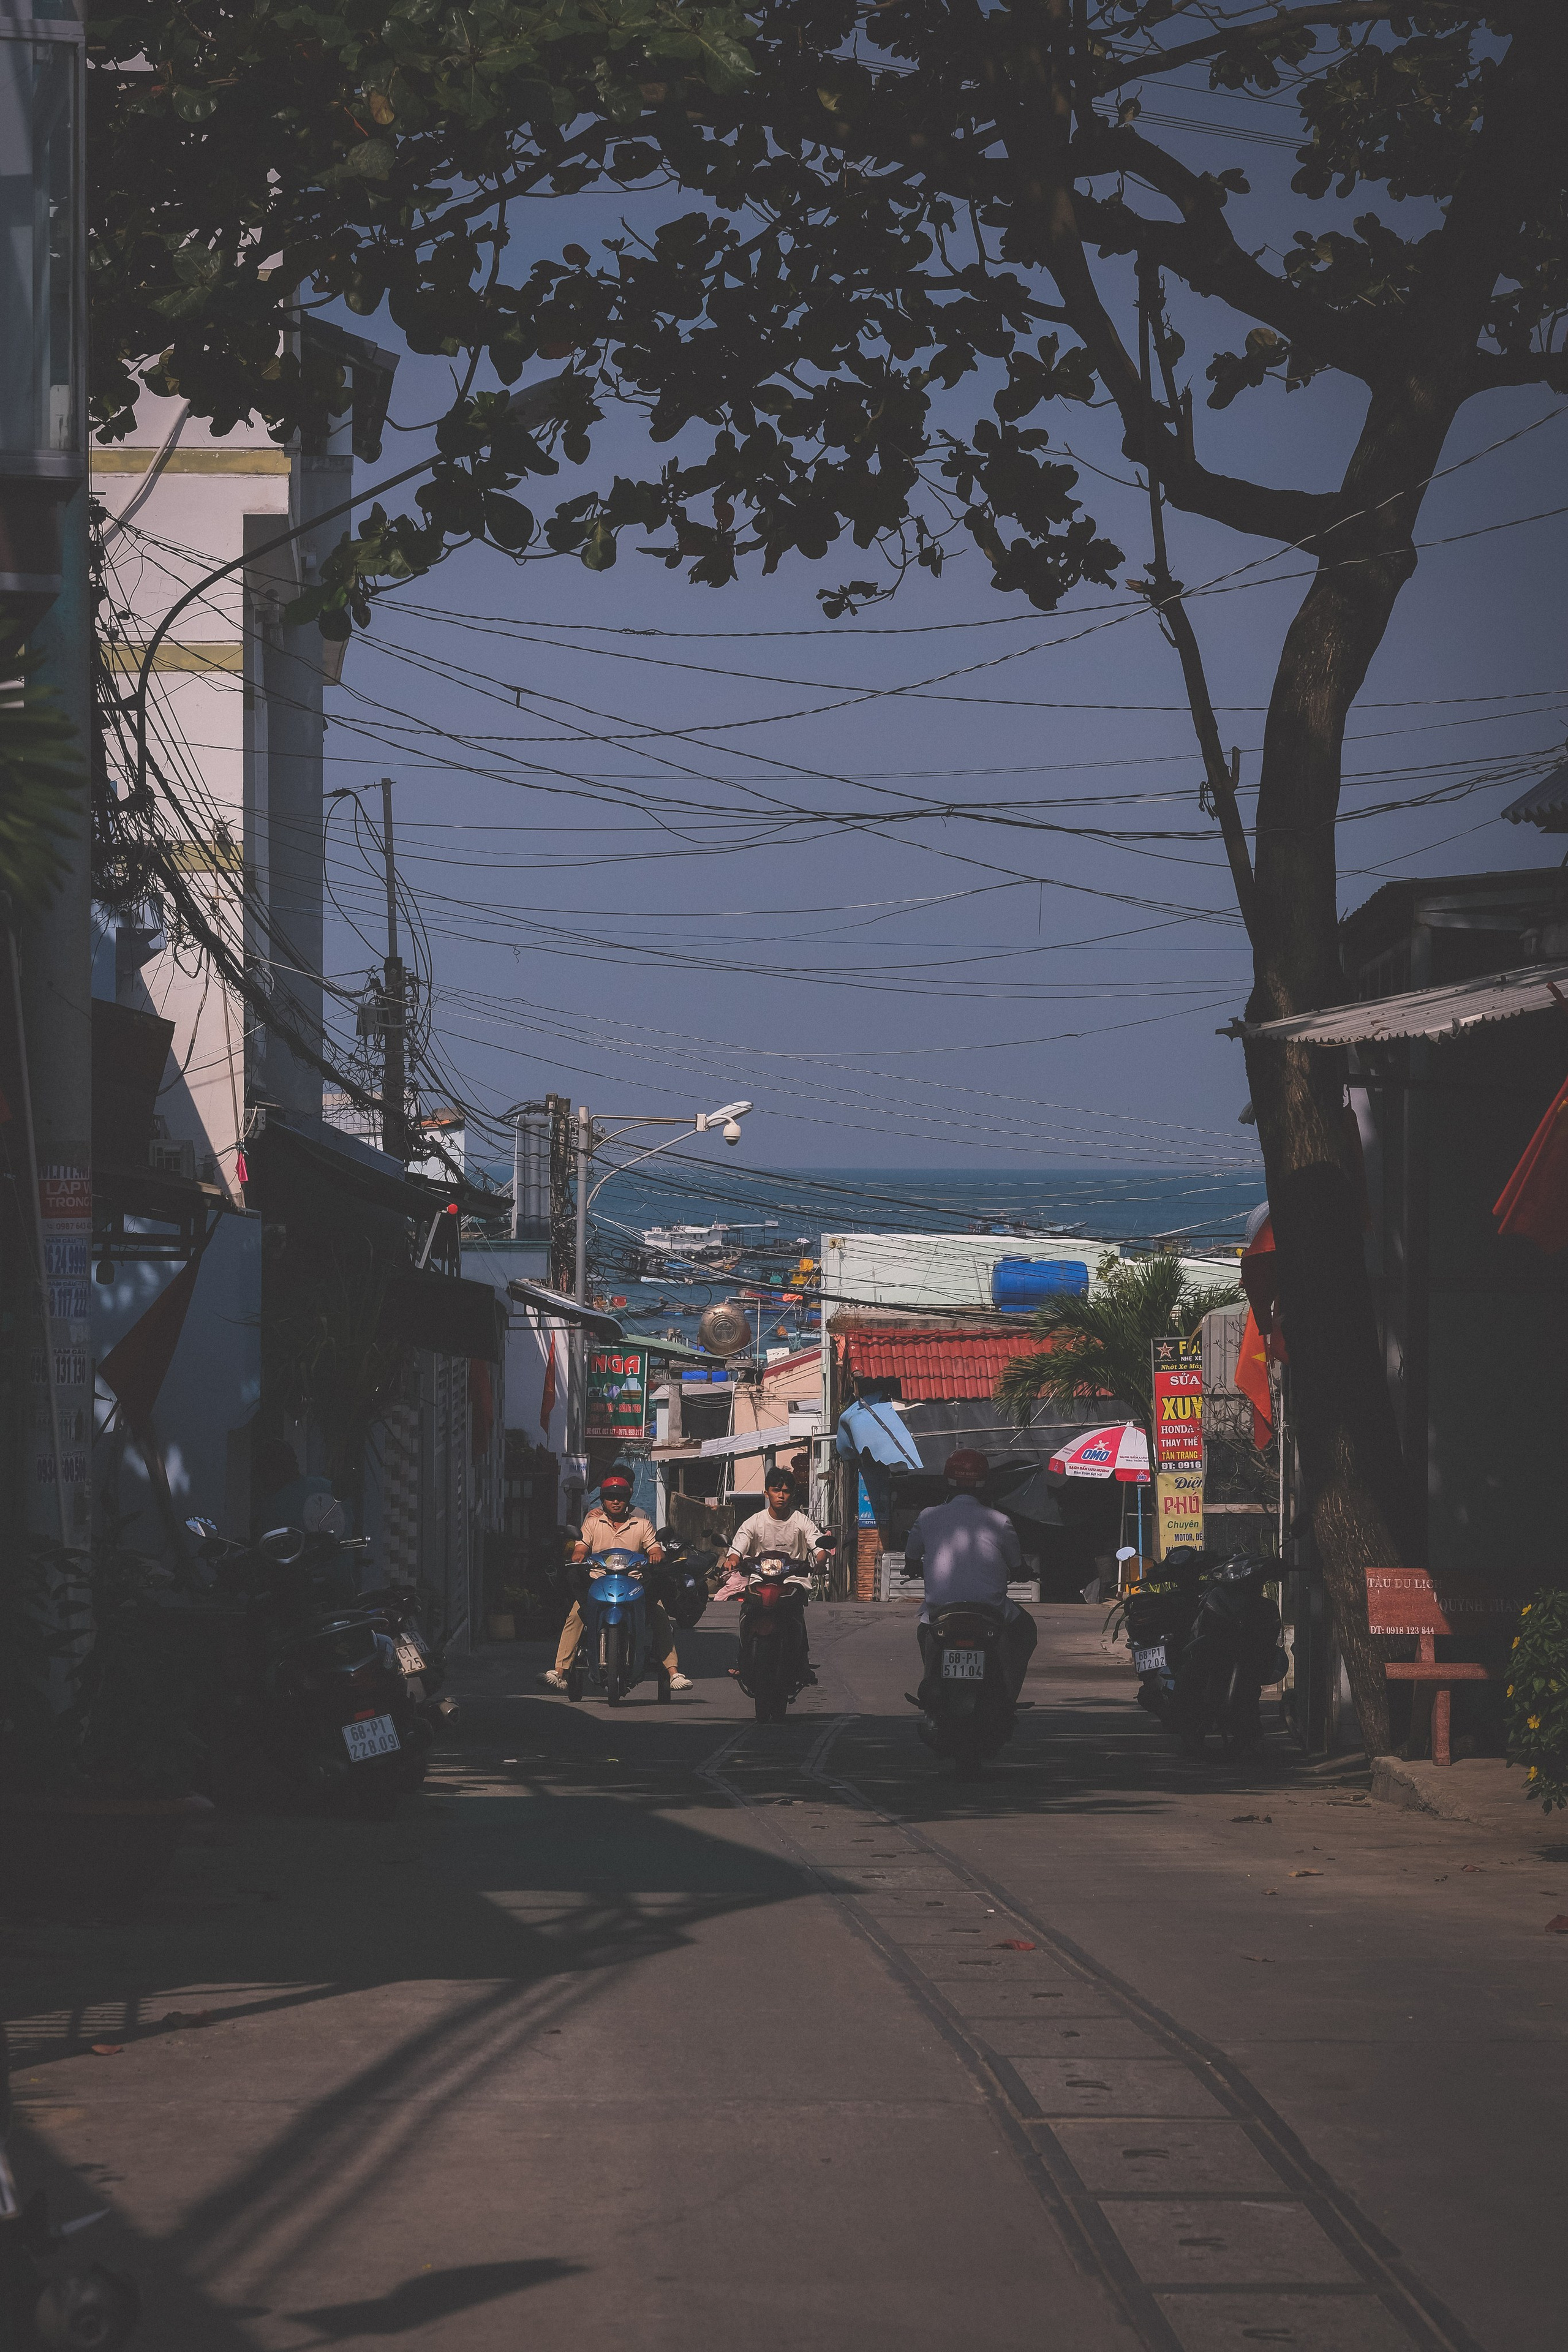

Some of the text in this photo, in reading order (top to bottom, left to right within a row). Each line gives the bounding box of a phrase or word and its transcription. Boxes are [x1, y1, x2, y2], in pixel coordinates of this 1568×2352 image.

[47, 1197, 89, 1207] TRONG
[591, 1354, 641, 1376] NGA
[1170, 1373, 1200, 1385] SỬA
[1161, 1425, 1194, 1434] HONDA
[1161, 1435, 1199, 1447] THAY THẾ
[1082, 1449, 1110, 1461] OMO
[1162, 1450, 1197, 1460] TÂN TRANG
[1178, 1461, 1202, 1469] 0916
[1164, 1491, 1200, 1515] PHÚ
[1167, 1520, 1199, 1530] Chuyên
[1174, 1533, 1194, 1542] MOTOR,
[1367, 1575, 1442, 1591] TÀU DU LỊCH
[1370, 1626, 1384, 1634] ĐT:
[949, 1652, 978, 1664] 68-P1
[1139, 1647, 1160, 1660] 68-P1
[944, 1664, 982, 1677] 511.04
[1136, 1657, 1165, 1672] 712.02
[350, 1719, 386, 1741] 68-P1
[350, 1734, 397, 1759] 228.09
